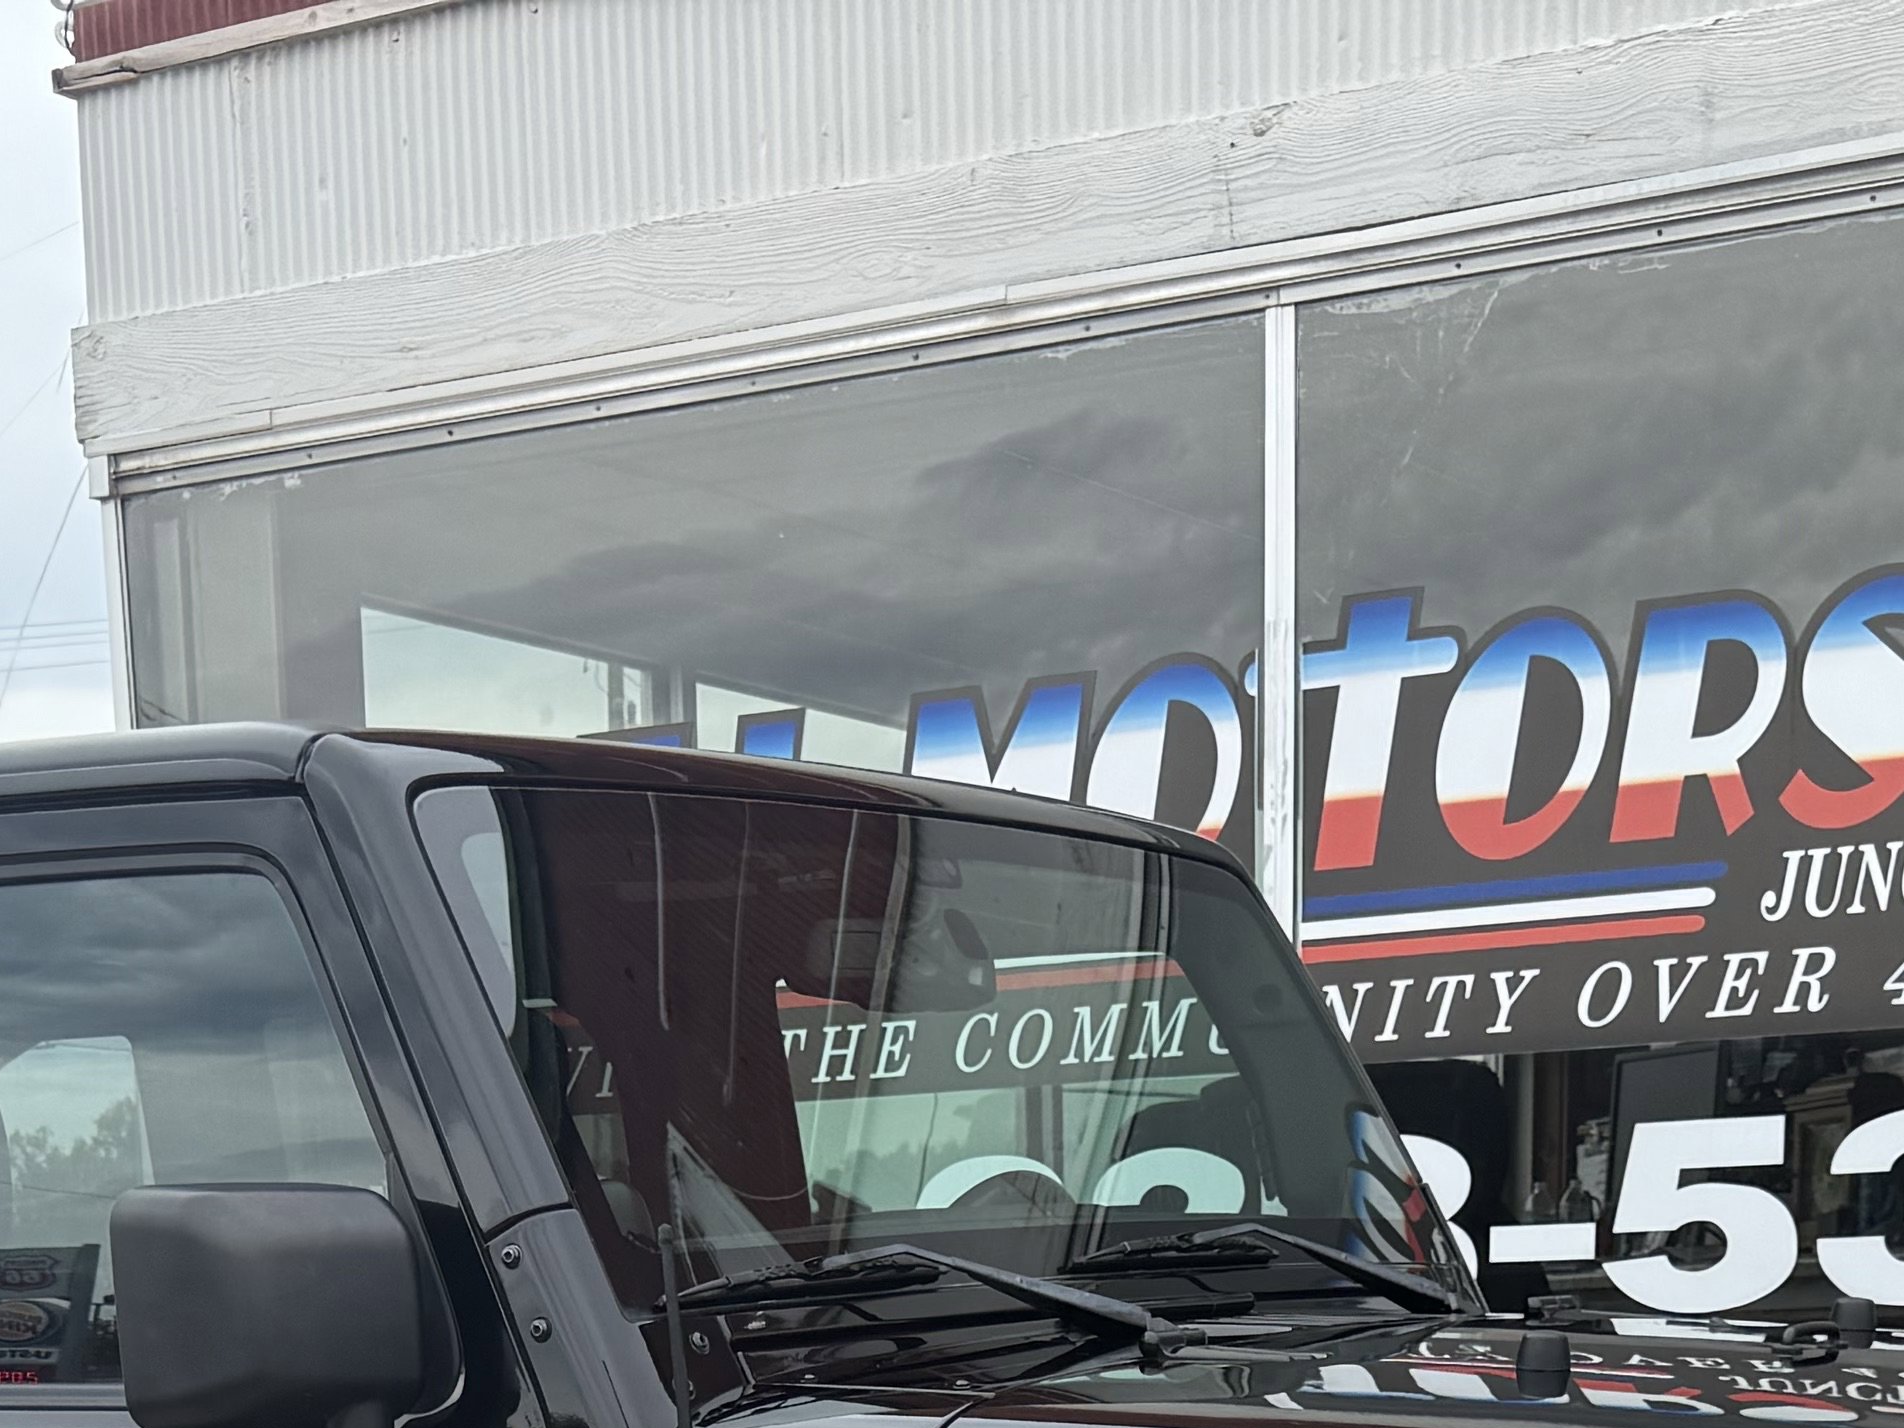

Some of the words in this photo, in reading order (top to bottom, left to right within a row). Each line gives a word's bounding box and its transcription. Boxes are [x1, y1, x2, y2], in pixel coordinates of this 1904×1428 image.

[784, 1020, 917, 1084] THE
[955, 968, 1540, 1074] COMMNITY
[1576, 946, 1838, 1028] OVER
